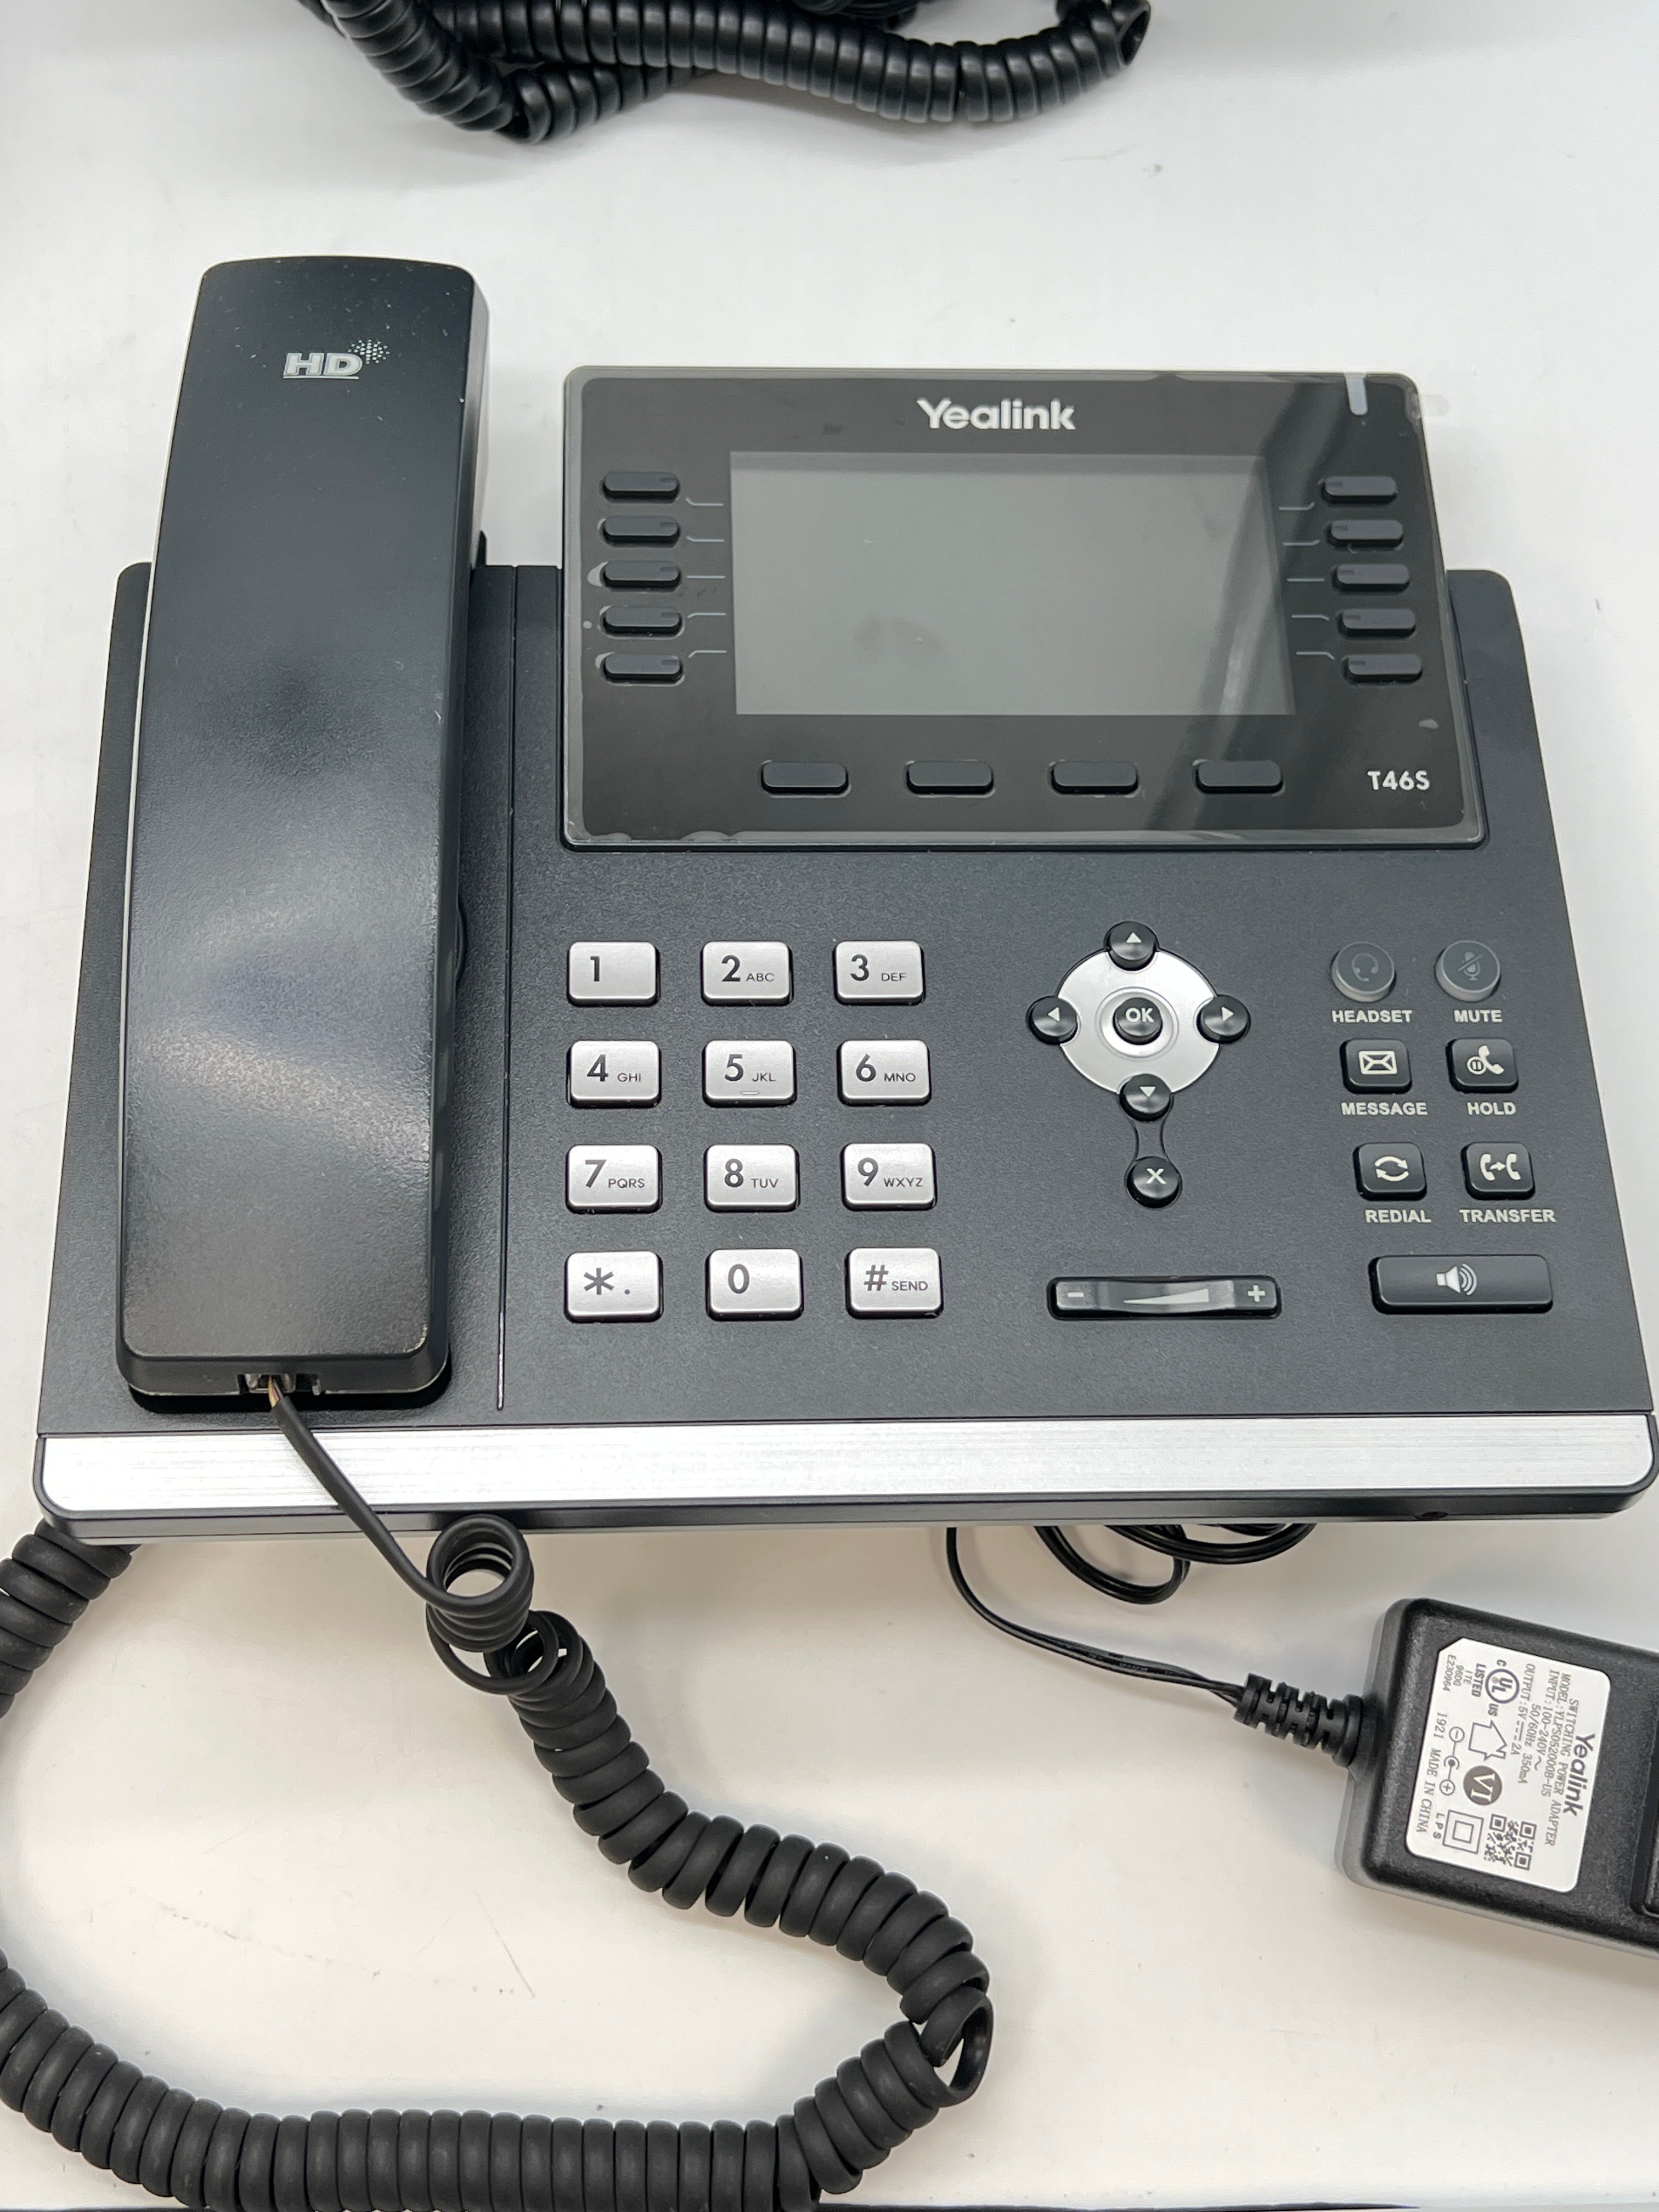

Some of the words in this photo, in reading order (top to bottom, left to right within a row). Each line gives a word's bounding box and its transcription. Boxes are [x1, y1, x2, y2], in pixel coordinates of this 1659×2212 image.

[283, 352, 363, 380] HD
[916, 398, 1076, 430] Yealink
[1367, 770, 1430, 791] T46S
[589, 955, 602, 983] 1
[721, 955, 741, 982] 2
[746, 972, 776, 983] ABC
[849, 954, 870, 981] 3
[881, 972, 907, 983] DEF
[1126, 1008, 1153, 1022] OK
[1333, 1011, 1412, 1022] HEADSET
[1454, 1010, 1502, 1022] MUTE
[586, 1053, 609, 1083] 4
[617, 1071, 642, 1083] GHI
[724, 1053, 744, 1083] 5
[751, 1071, 777, 1083] JKL
[855, 1053, 877, 1083] 6
[884, 1071, 917, 1083] MNO
[1342, 1103, 1427, 1115] MESSAGE
[1468, 1103, 1515, 1115] HOLD
[584, 1158, 606, 1188] 7
[608, 1177, 645, 1189] PQRS
[724, 1158, 744, 1188] 8
[751, 1177, 779, 1189] TUV
[856, 1157, 879, 1188] 9
[883, 1176, 923, 1188] WXYZ
[1365, 1210, 1431, 1222] REDIAL
[1460, 1210, 1555, 1222] TRANSFER
[727, 1263, 751, 1295] 0
[864, 1263, 889, 1292] #
[891, 1280, 928, 1292] SEND
[1463, 1669, 1472, 1685] ITE
[1471, 1663, 1486, 1697] LISTED
[1487, 1703, 1498, 1716] US
[1433, 1712, 1447, 1738] 1921
[1524, 1703, 1541, 1747] 50/60Hz
[1560, 1698, 1579, 1757] SWITCHING
[1426, 1747, 1441, 1777] MADE
[1517, 1752, 1532, 1784] 350mA
[1562, 1733, 1595, 1816] Yealink
[1424, 1780, 1435, 1796] IN
[1470, 1773, 1494, 1801] VI
[1553, 1762, 1568, 1795] POWER
[1416, 1798, 1432, 1832] CHINA
[1544, 1799, 1561, 1846] ADAPTER
